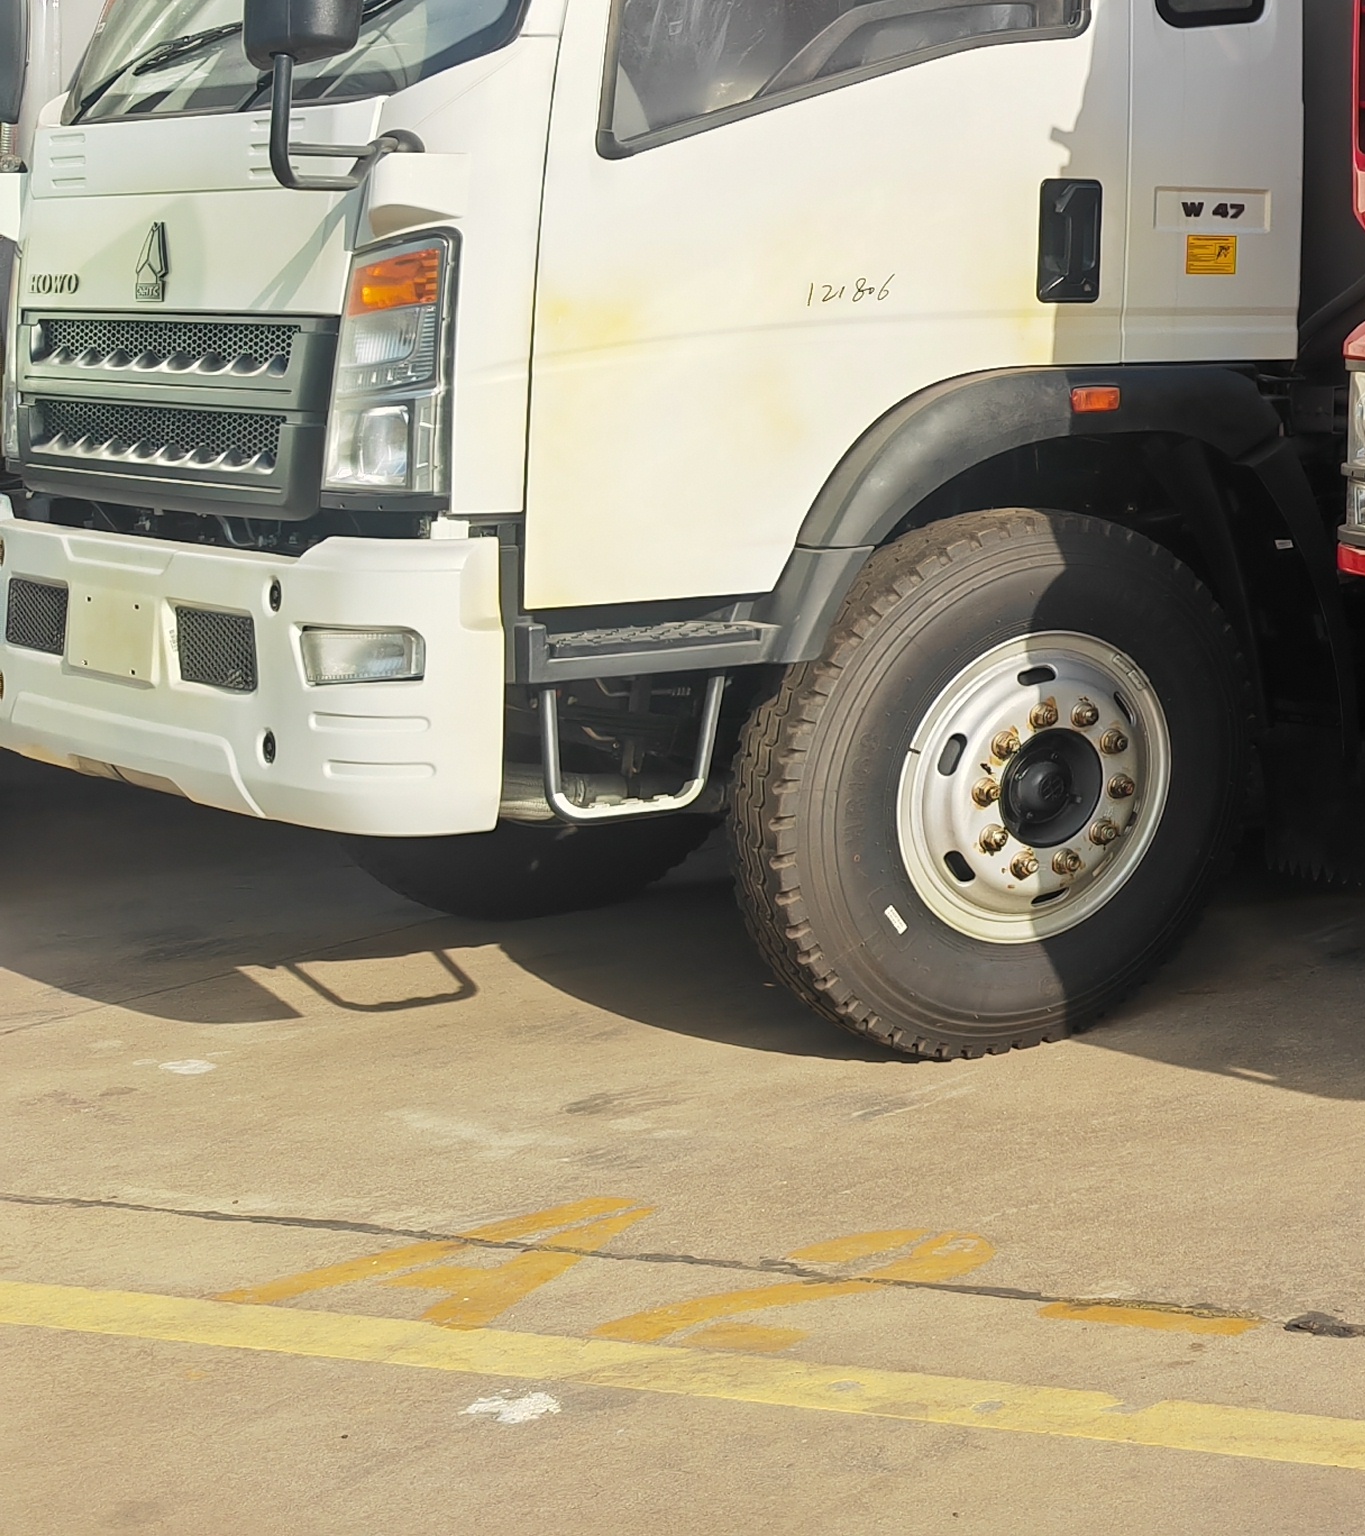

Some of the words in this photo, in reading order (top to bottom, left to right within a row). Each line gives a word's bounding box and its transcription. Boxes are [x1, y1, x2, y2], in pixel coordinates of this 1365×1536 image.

[1181, 201, 1205, 218] W
[1211, 202, 1246, 220] 47
[28, 272, 79, 295] HOWO
[806, 273, 896, 307] 121806
